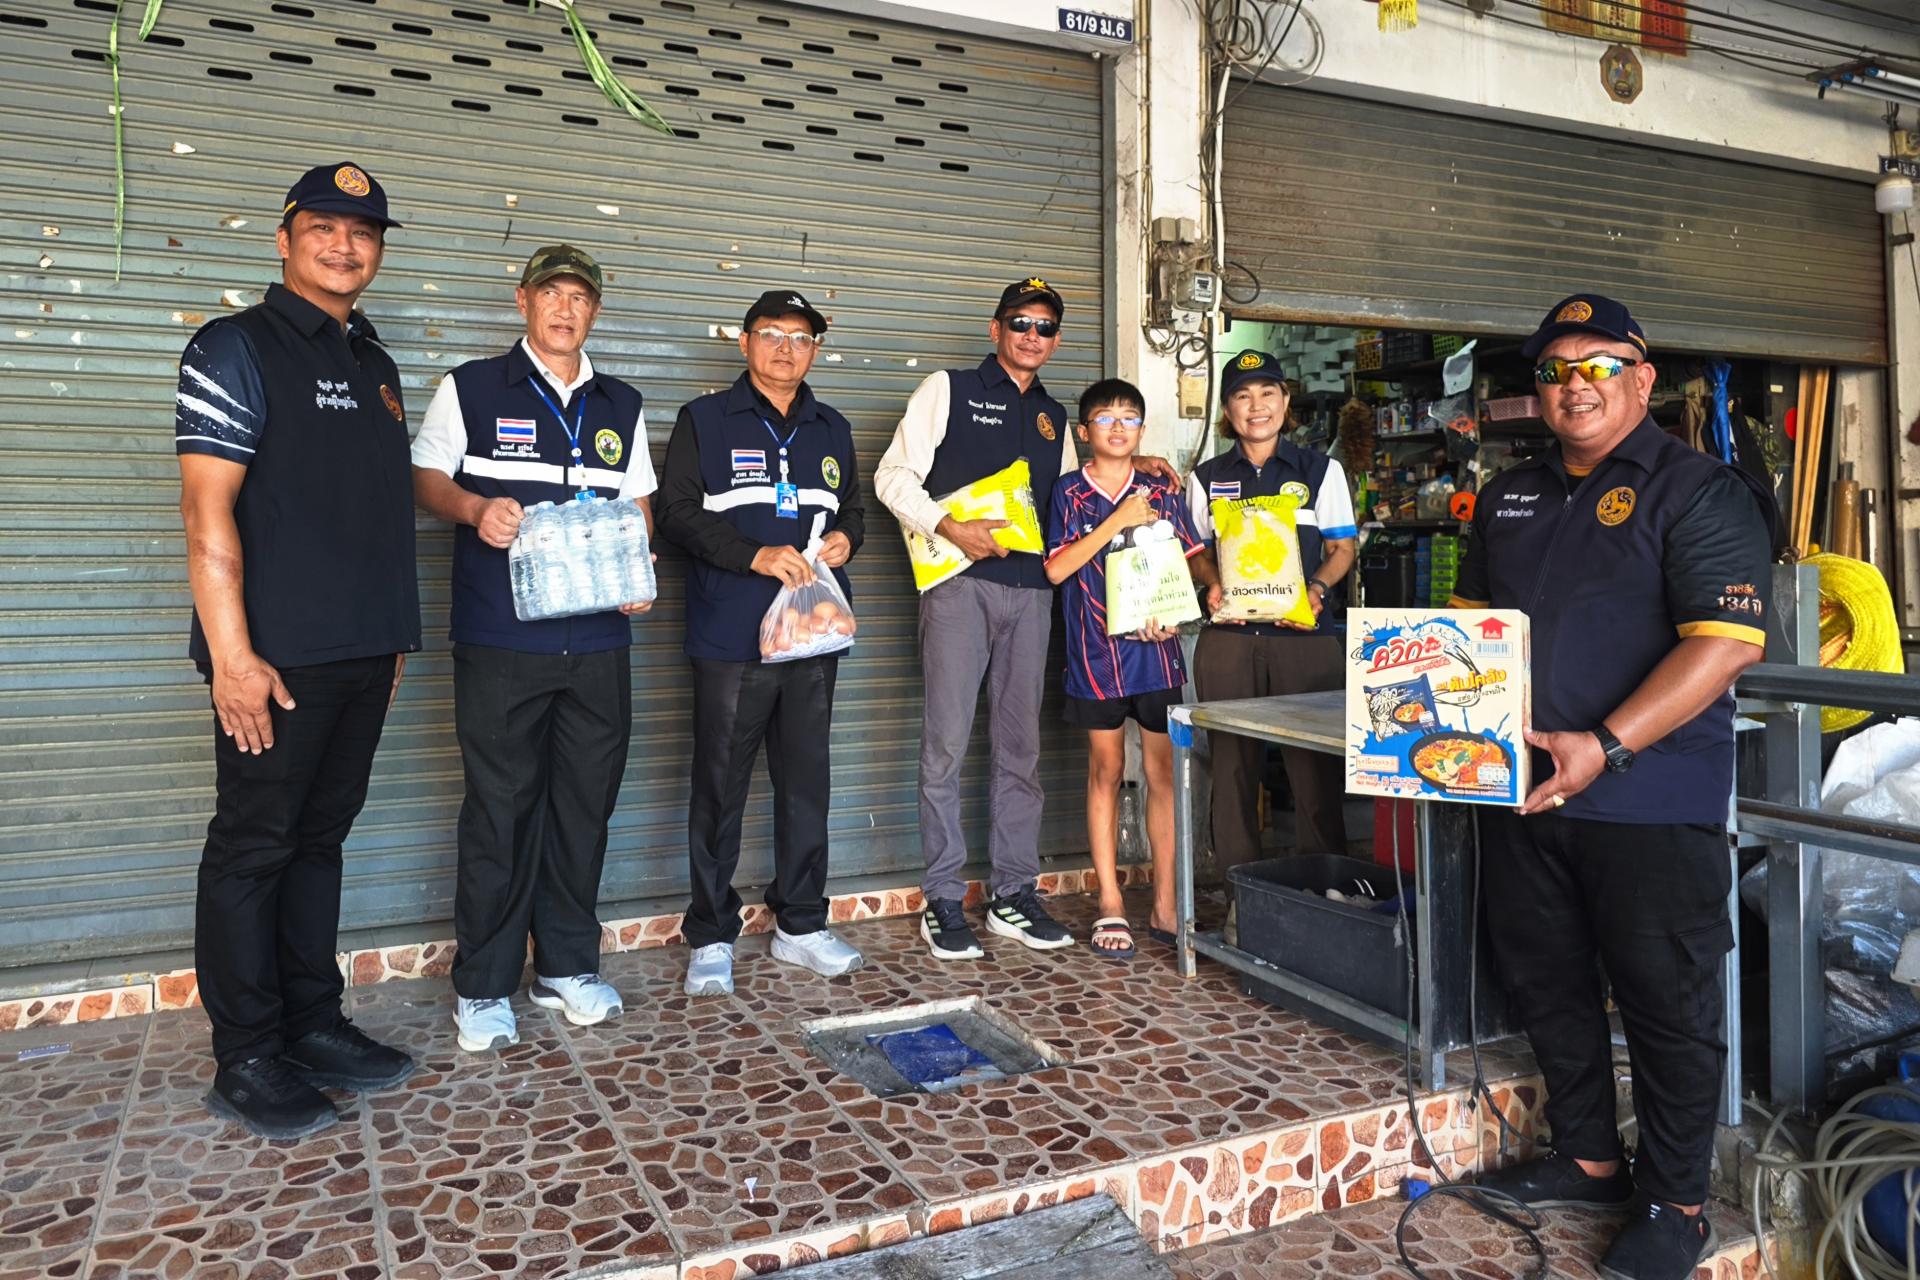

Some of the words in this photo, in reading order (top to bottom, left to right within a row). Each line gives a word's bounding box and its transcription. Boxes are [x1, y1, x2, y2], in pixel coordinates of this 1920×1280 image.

[1065, 12, 1098, 33] 61/9
[1100, 18, 1126, 38] ม.6
[1231, 583, 1294, 597] ข้าวตราไก่แจ้
[1716, 596, 1750, 614] 134
[1373, 637, 1423, 668] ควิก
